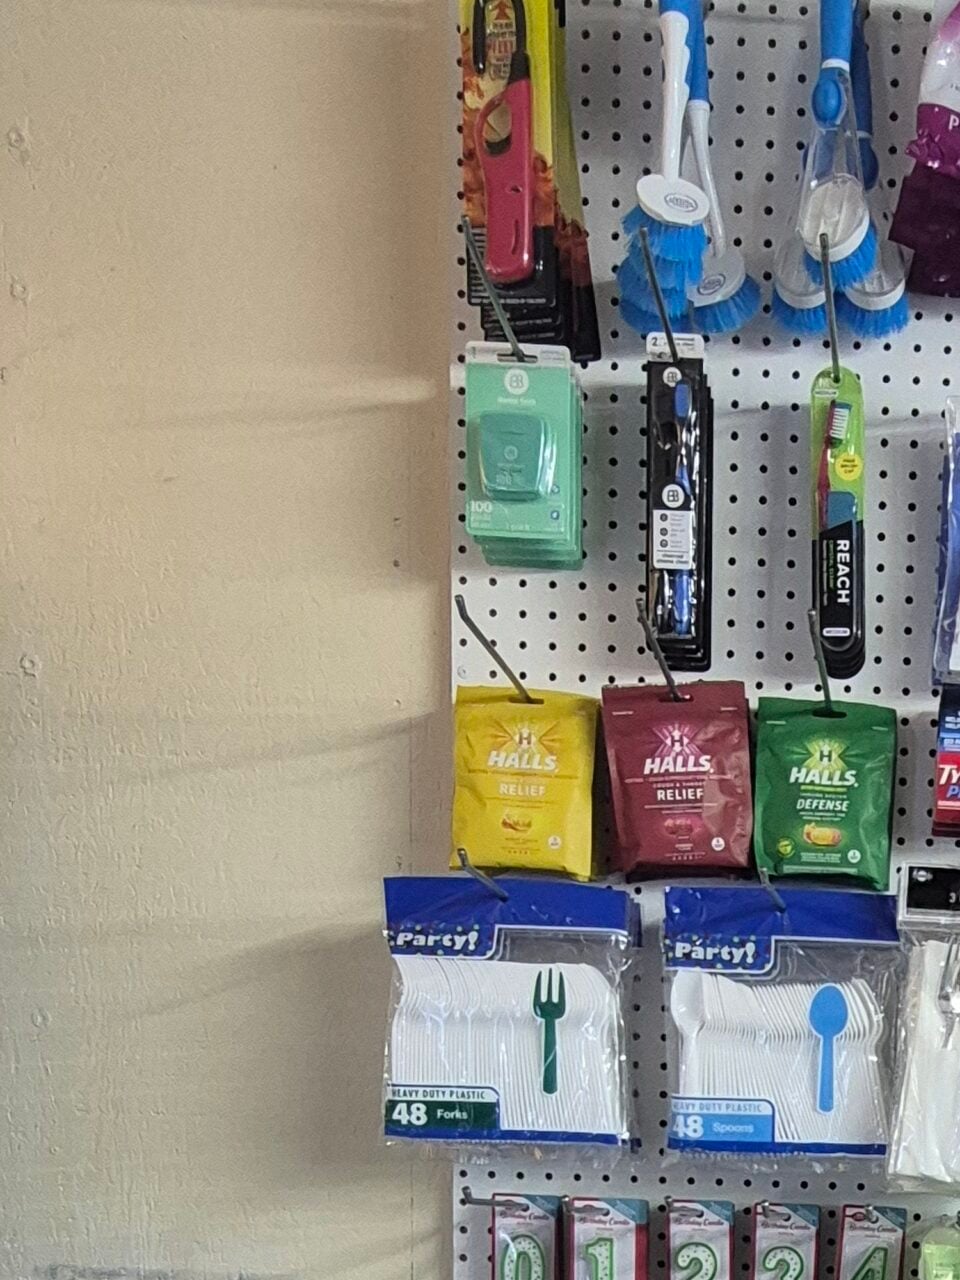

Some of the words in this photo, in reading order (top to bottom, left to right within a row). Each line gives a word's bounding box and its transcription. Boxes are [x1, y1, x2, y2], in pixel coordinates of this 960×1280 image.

[651, 336, 658, 346] 2
[470, 500, 493, 513] 100
[837, 539, 851, 604] REACH
[487, 750, 557, 770] HALLS
[643, 755, 712, 774] HALLS
[789, 766, 857, 785] HALLS
[499, 783, 545, 797] RELIEF
[656, 788, 705, 801] RELIEF
[796, 798, 850, 811] DEFENSE
[949, 892, 956, 903] 3
[395, 931, 479, 952] Party!
[675, 940, 756, 965] Party!
[421, 1089, 446, 1100] DUTY
[449, 1089, 486, 1101] PLASTIC
[391, 1103, 428, 1126] 48
[437, 1109, 469, 1120] Forks
[700, 1102, 724, 1113] DUTY
[726, 1103, 763, 1114] PLASTIC
[672, 1114, 704, 1138] 48
